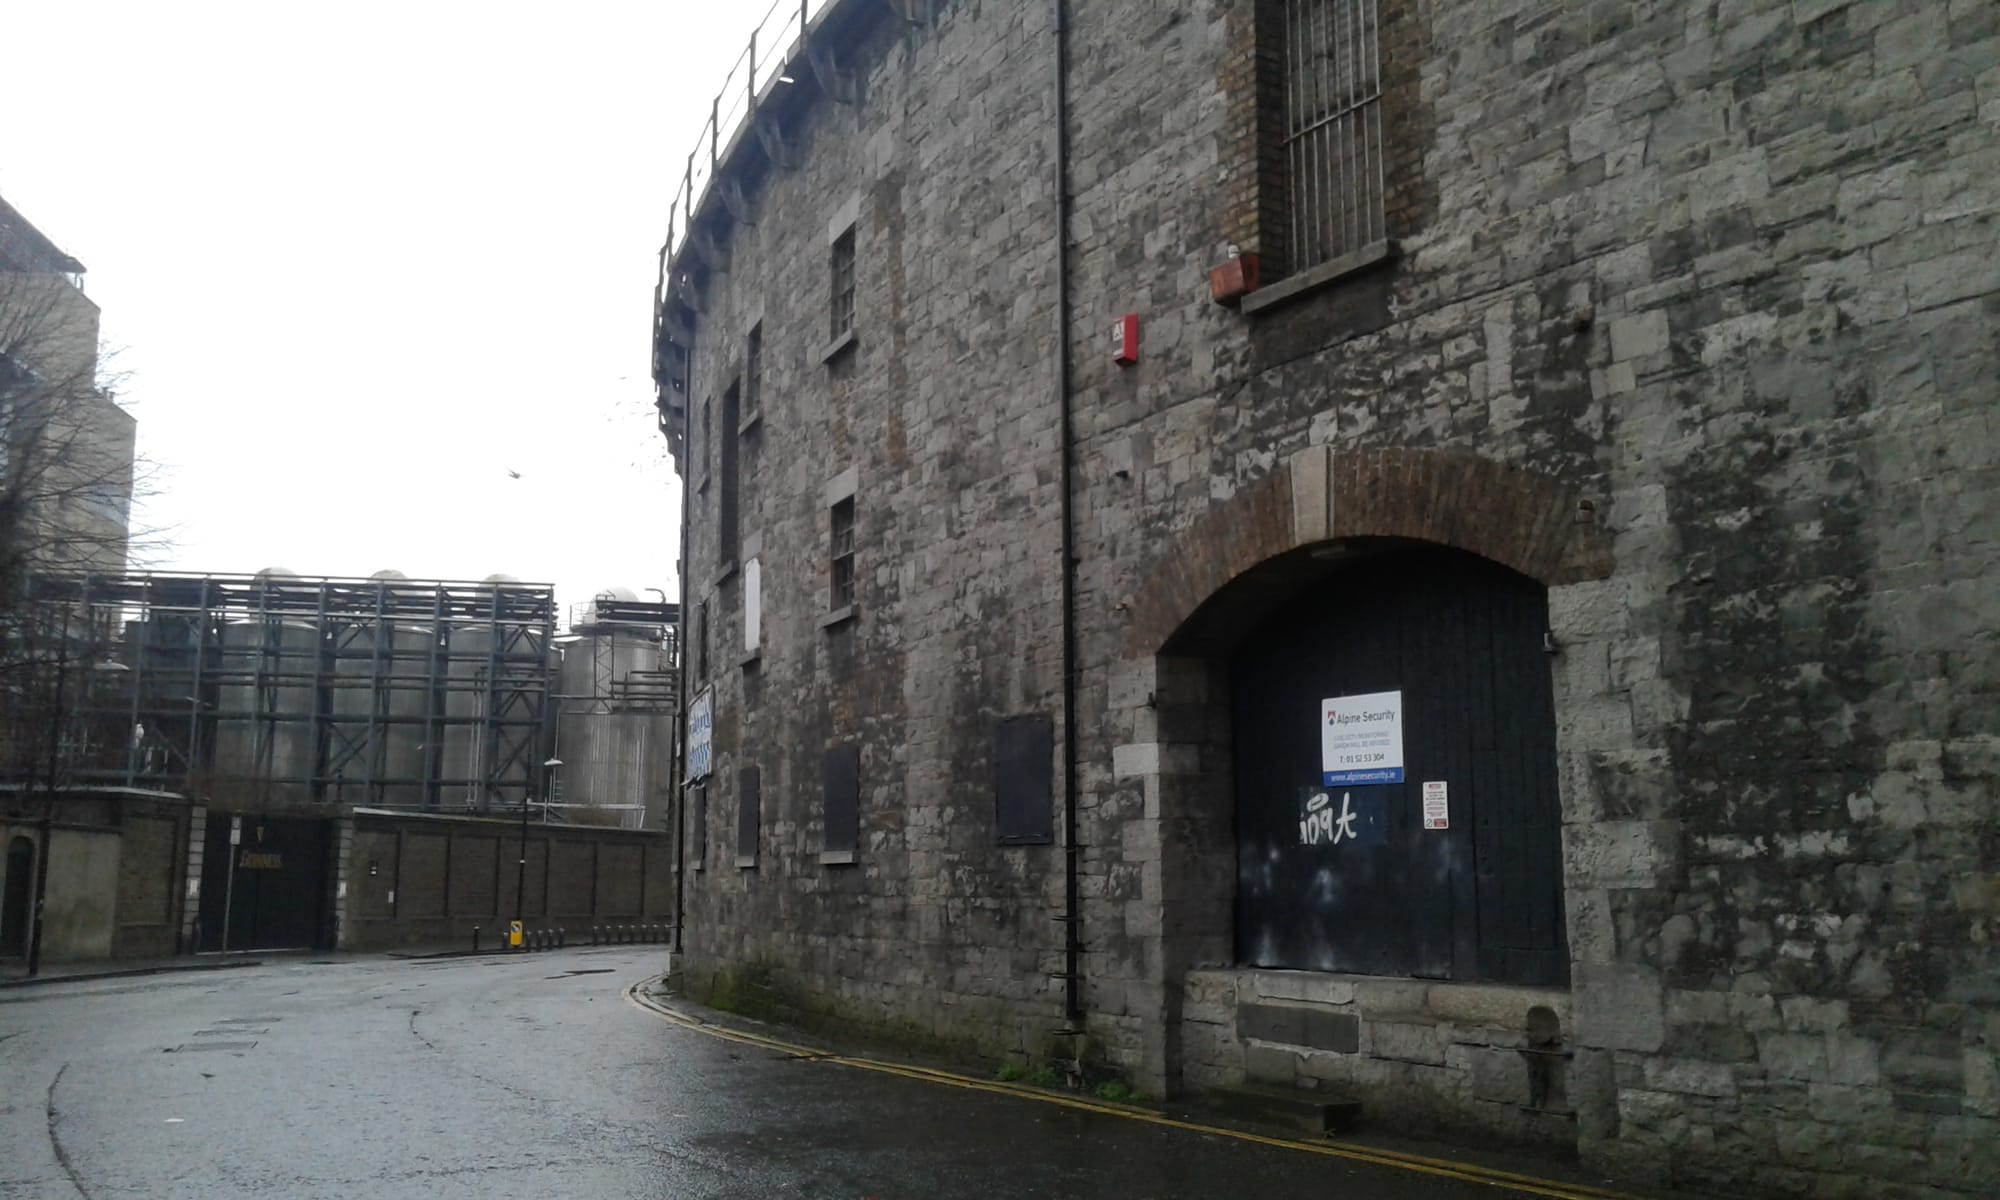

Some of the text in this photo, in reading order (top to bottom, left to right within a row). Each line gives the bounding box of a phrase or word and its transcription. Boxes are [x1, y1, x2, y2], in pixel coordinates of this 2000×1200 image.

[1337, 710, 1395, 726] Alpine Security
[1331, 770, 1396, 783] www.alpinesecurity.ie
